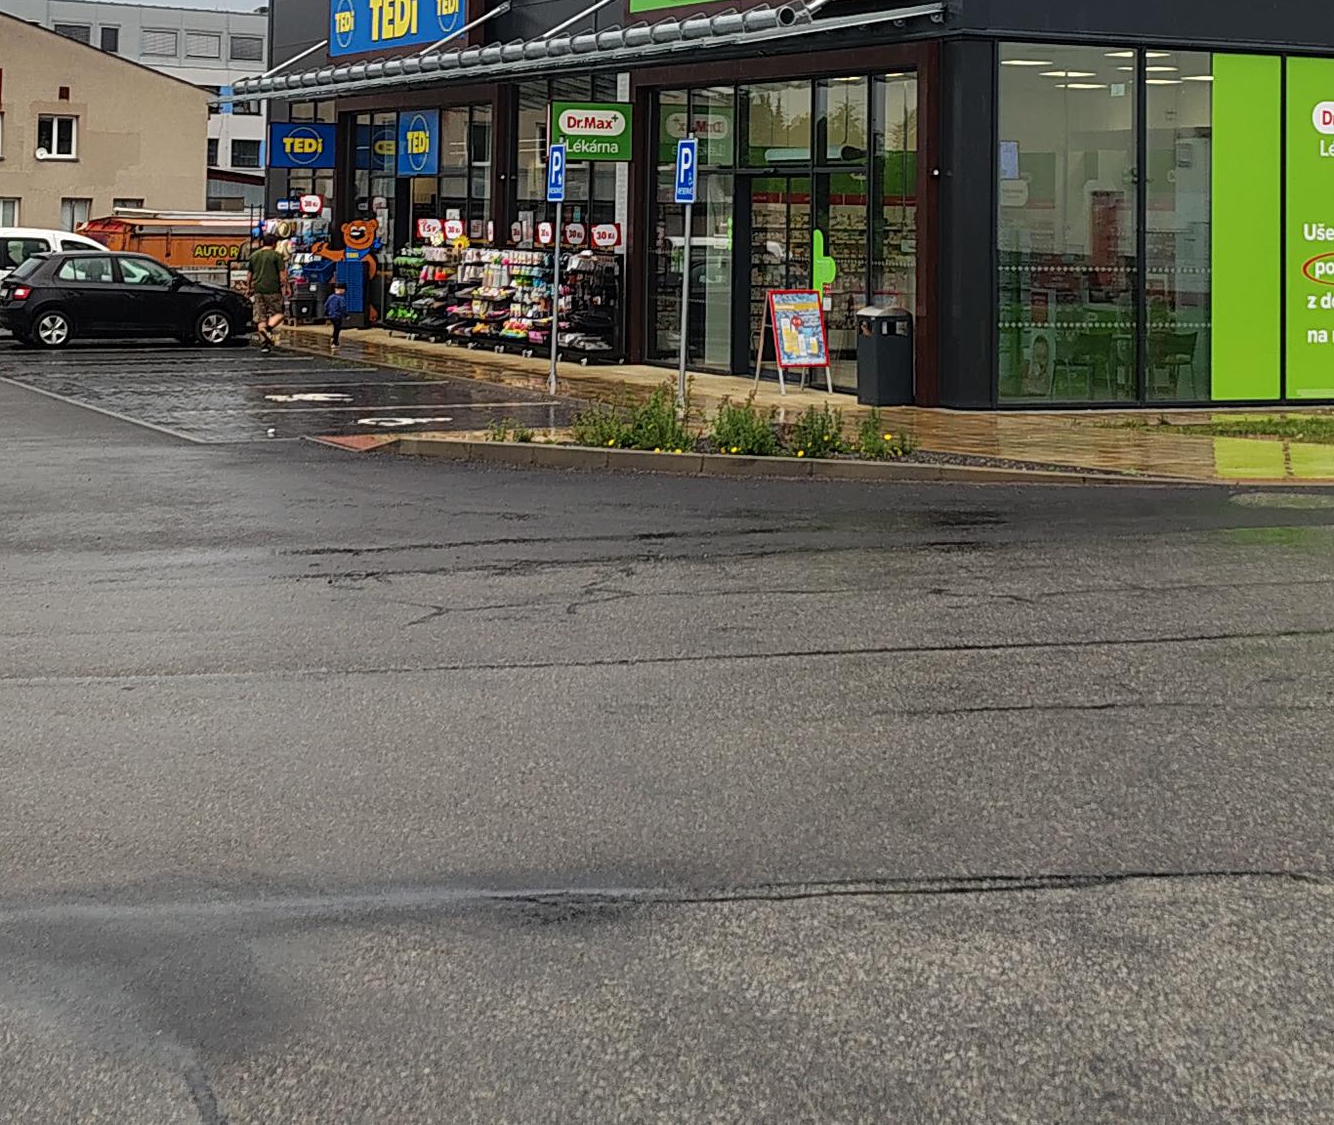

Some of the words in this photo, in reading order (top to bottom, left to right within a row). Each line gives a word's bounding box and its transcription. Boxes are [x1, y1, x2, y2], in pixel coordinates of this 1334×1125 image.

[334, 10, 355, 33] TEDi
[283, 137, 323, 154] TEDi
[406, 130, 430, 154] TEDi
[566, 139, 619, 154] Lékárna
[551, 151, 562, 184] P
[680, 147, 692, 183] P
[194, 245, 227, 257] AUTO
[1307, 295, 1317, 309] z
[1307, 329, 1328, 343] na
